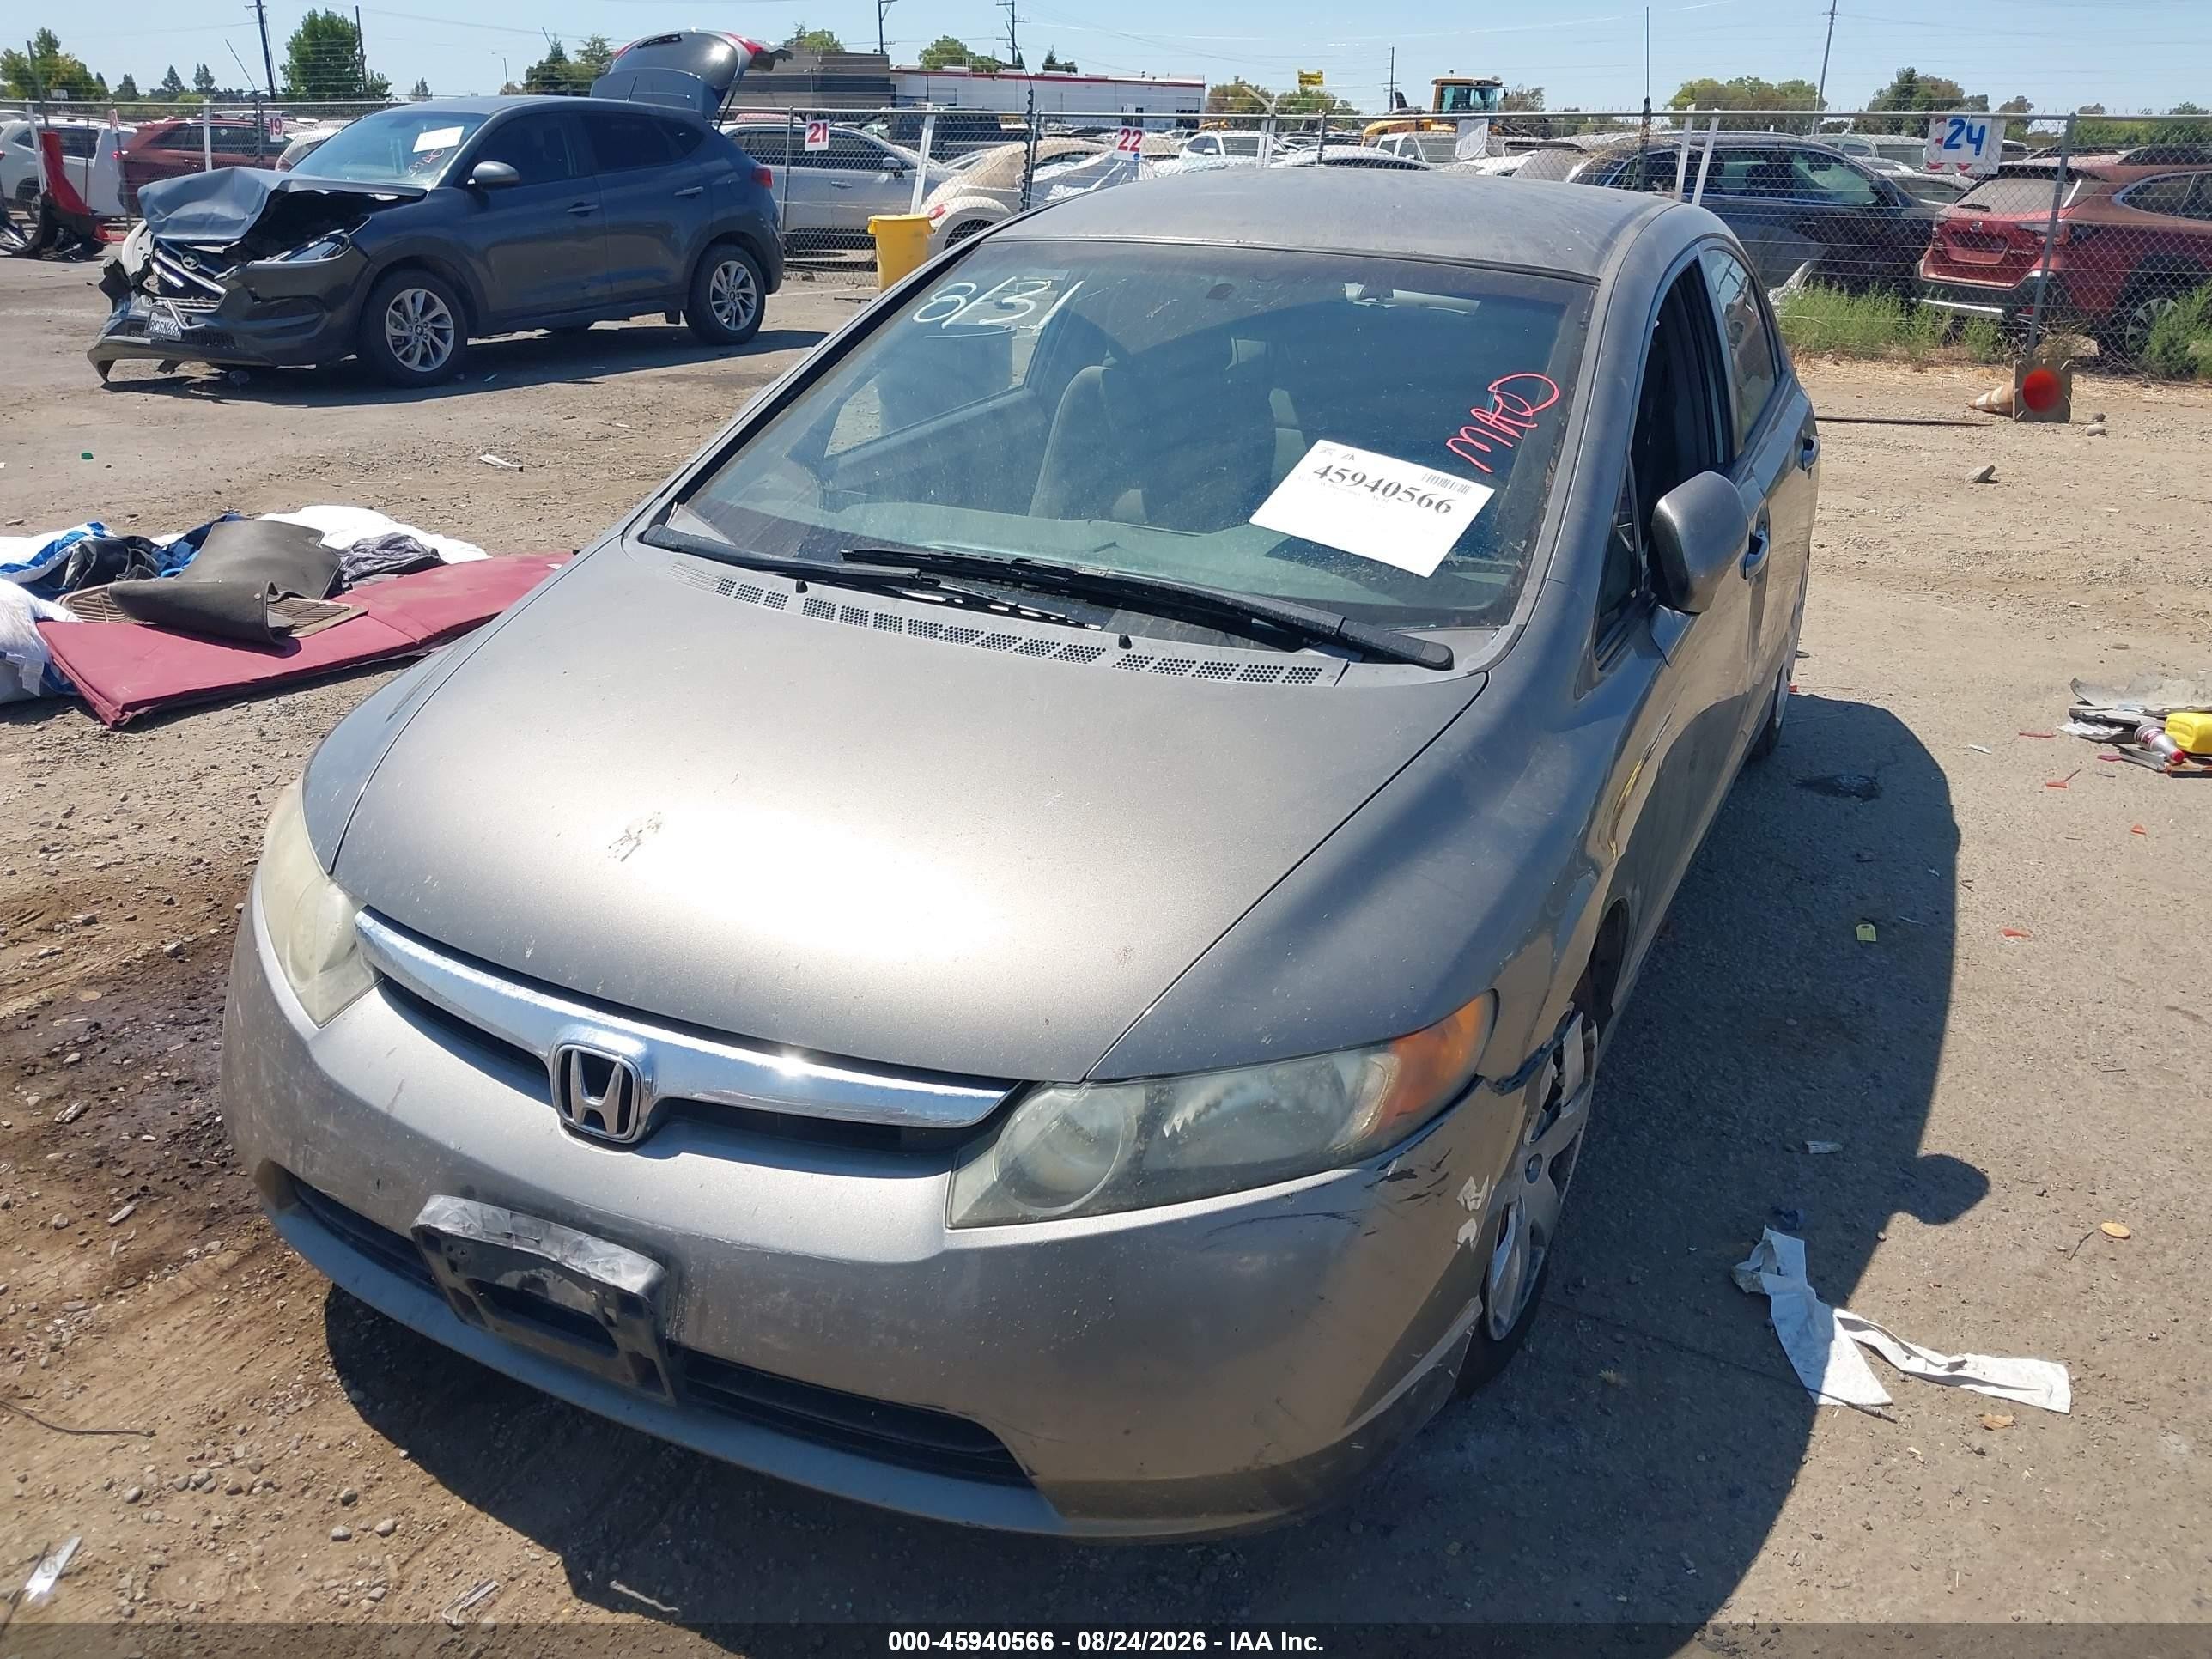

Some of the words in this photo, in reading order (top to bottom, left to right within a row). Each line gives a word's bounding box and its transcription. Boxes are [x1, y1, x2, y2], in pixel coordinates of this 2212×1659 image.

[270, 118, 283, 136] 19
[807, 122, 828, 143] 21
[1117, 127, 1144, 152] 22
[1943, 118, 1987, 156] 24
[913, 276, 1085, 336] 8/31
[1313, 465, 1458, 514] 45940566
